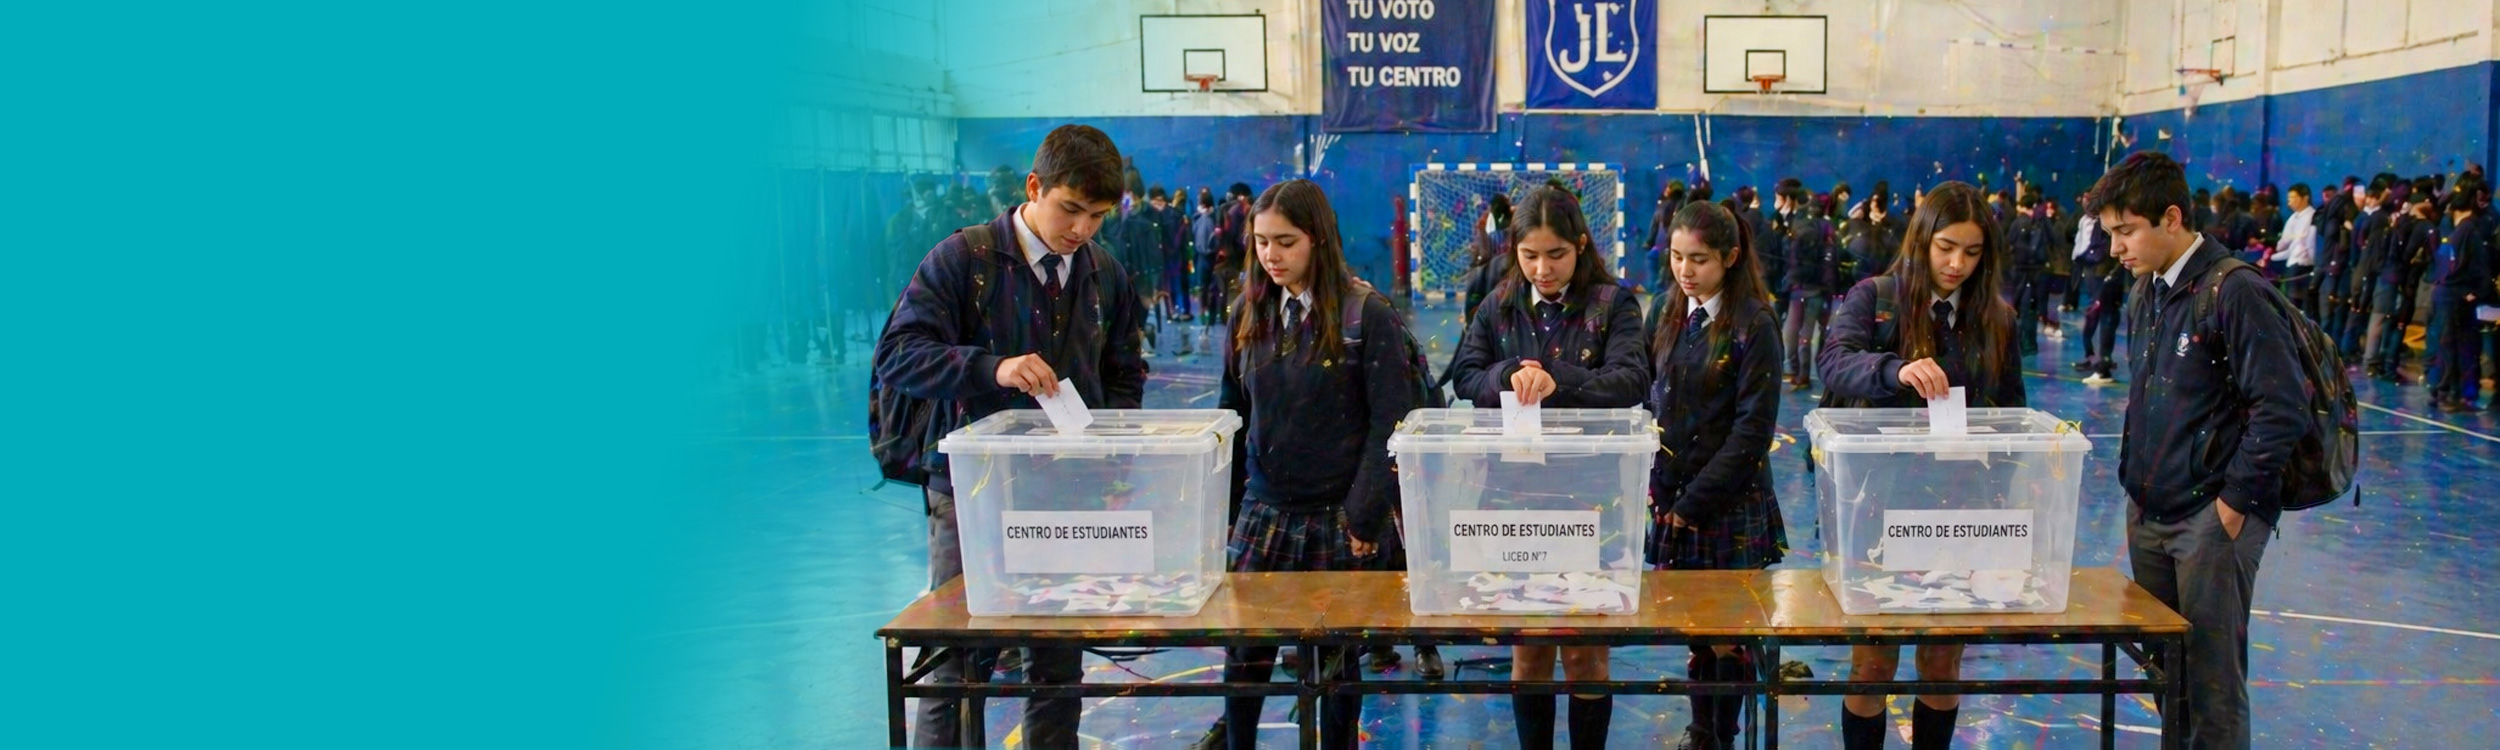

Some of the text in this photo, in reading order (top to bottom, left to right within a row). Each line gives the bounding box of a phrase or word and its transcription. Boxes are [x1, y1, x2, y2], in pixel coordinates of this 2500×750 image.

[1346, 0, 1435, 20] TU VOTO
[1346, 32, 1421, 53] TU VOZ
[1346, 66, 1461, 88] TU CENTRO
[1006, 525, 1148, 539] CENTRO DE ESTUDIANTES
[1453, 523, 1595, 537] CENTRO DE ESTUDIANTES
[1888, 524, 2028, 538] CENTRO DE ESTUDIANTES
[1502, 551, 1529, 562] LICEO
